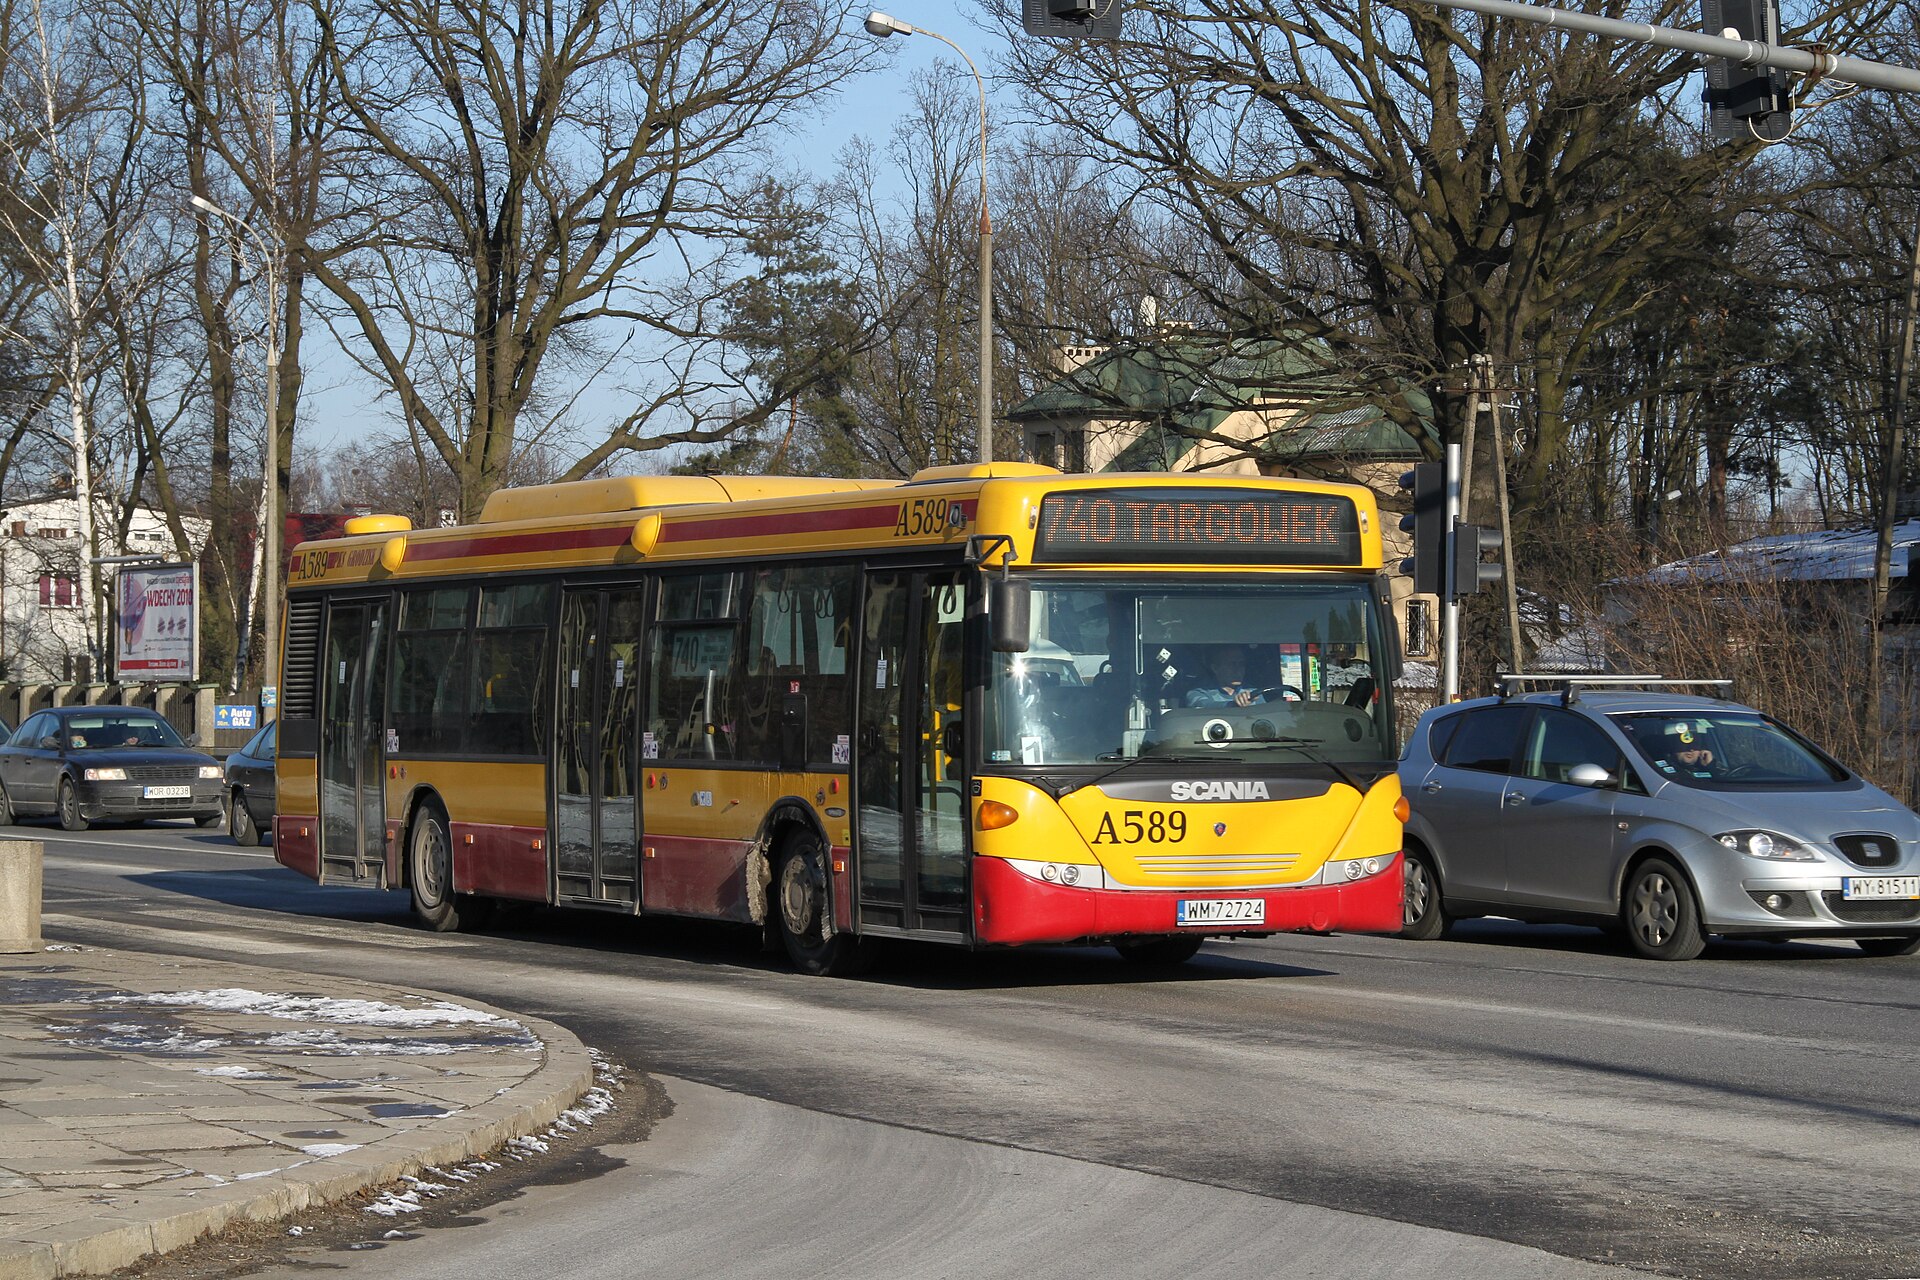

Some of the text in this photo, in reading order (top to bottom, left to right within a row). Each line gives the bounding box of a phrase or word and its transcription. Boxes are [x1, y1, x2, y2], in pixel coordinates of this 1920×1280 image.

[894, 498, 947, 536] A589
[1045, 498, 1116, 542] 740
[298, 551, 329, 580] A589
[147, 588, 193, 607] WDECHY 2010
[673, 636, 699, 672] 740
[231, 708, 252, 717] Auto
[232, 717, 250, 727] GAZ
[1025, 741, 1040, 763] 1
[1171, 781, 1270, 800] SCANIA
[1091, 810, 1187, 844] A589
[1853, 879, 1916, 894] WY 81511
[1188, 901, 1262, 918] WM 72724
